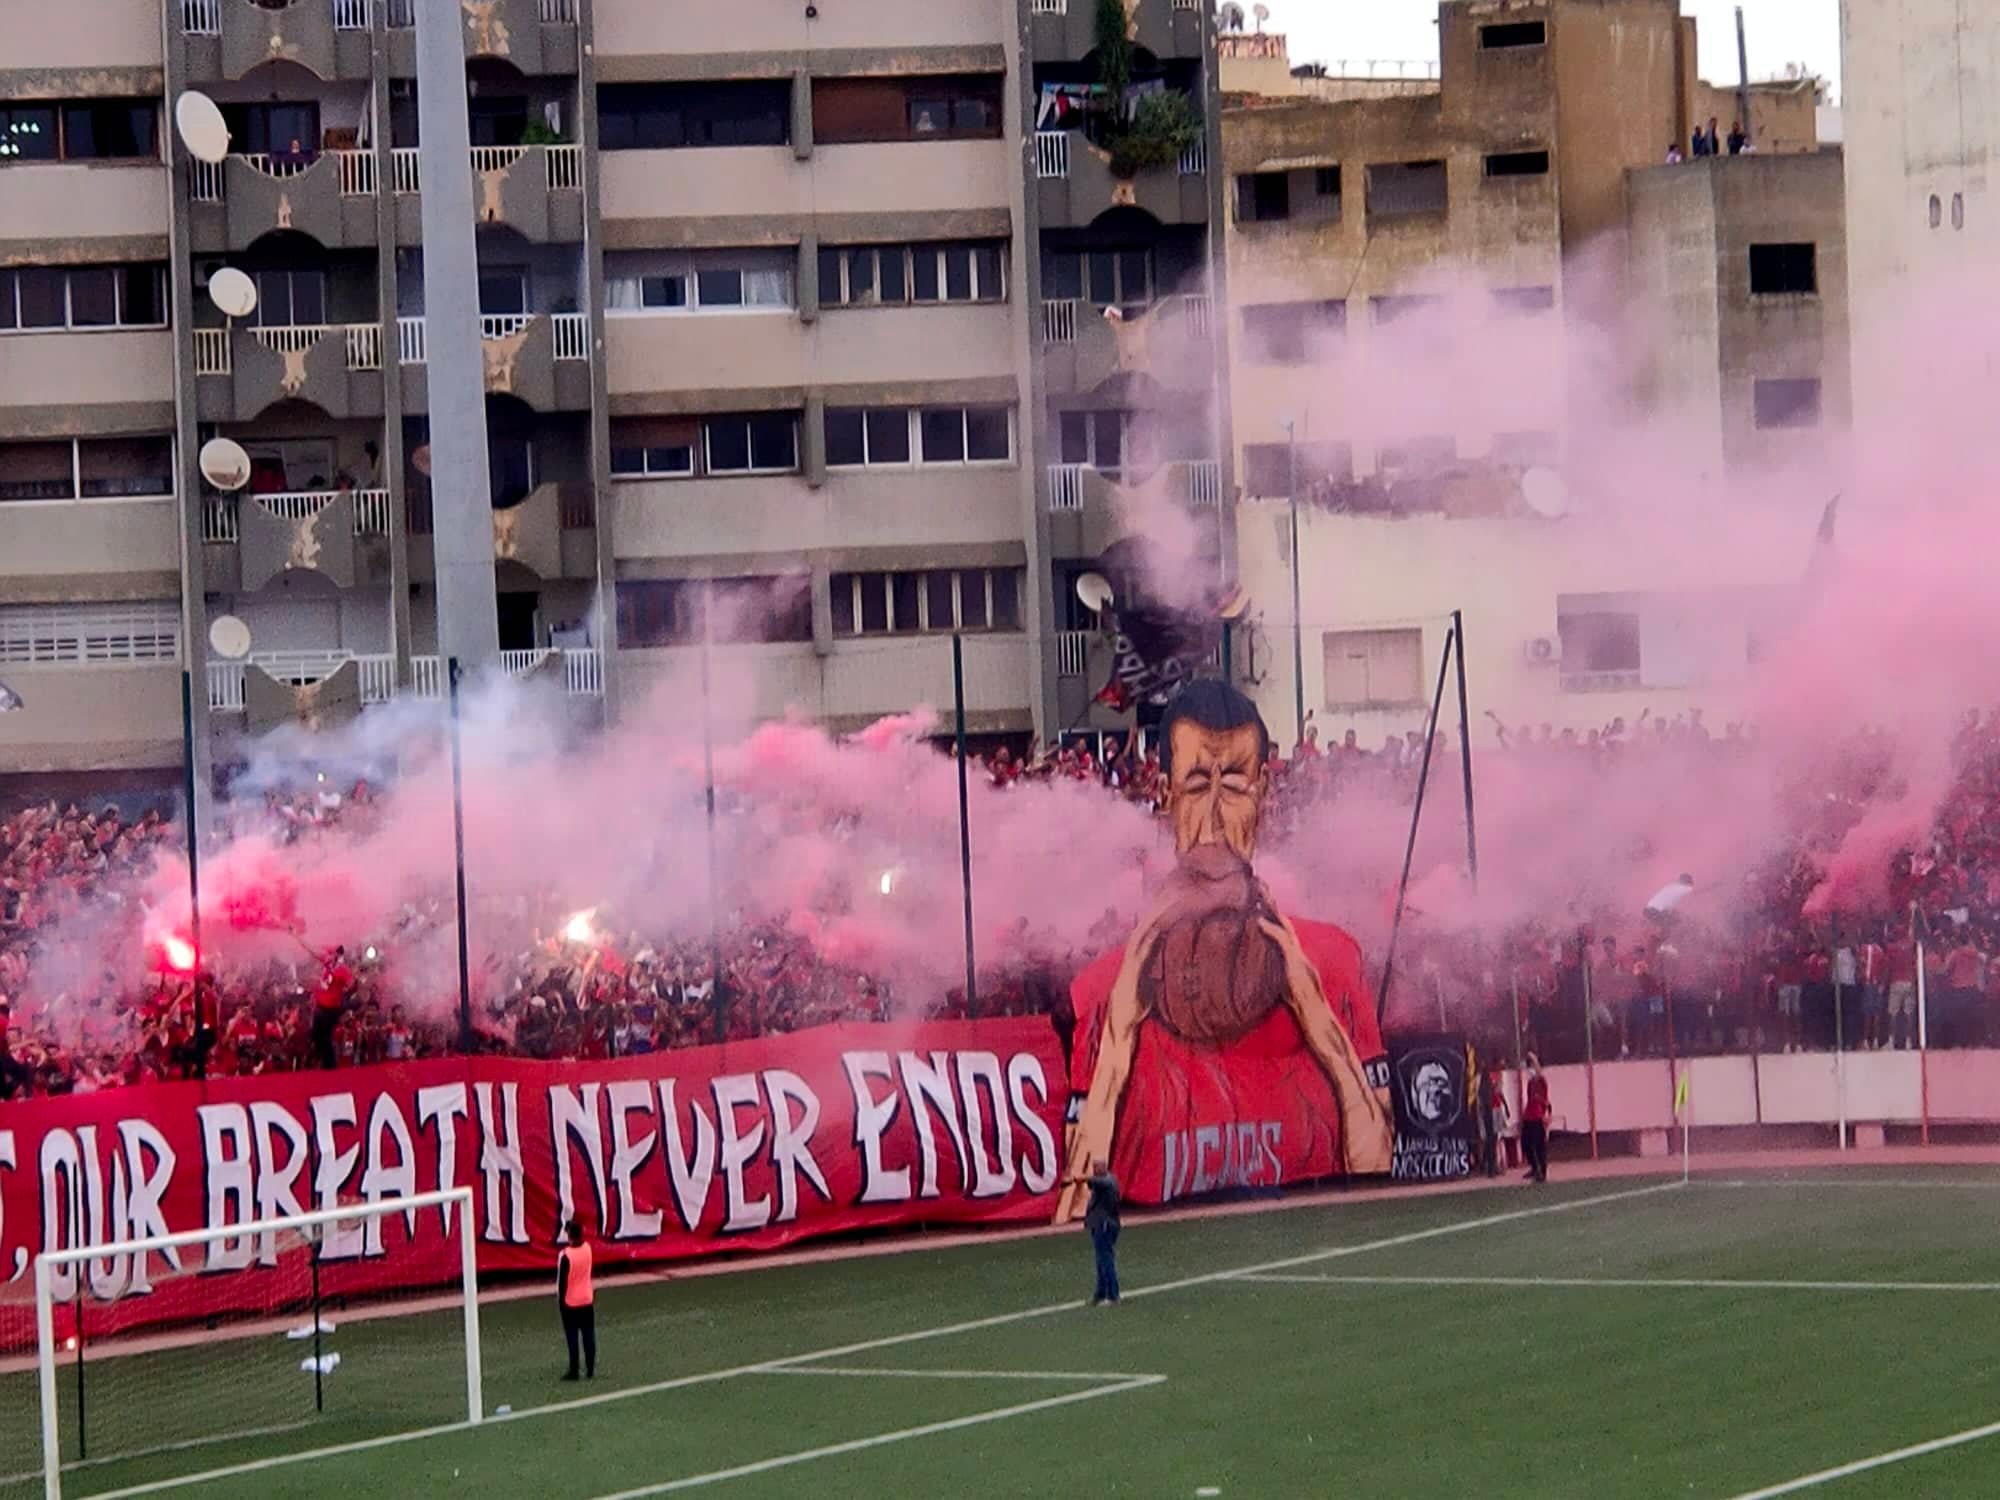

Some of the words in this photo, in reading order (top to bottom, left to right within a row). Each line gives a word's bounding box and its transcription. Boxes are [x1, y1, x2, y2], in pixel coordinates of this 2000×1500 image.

[40, 1118, 183, 1301] OUR
[197, 1081, 530, 1272] BREATH
[549, 1069, 832, 1243] NEVER
[842, 1050, 1058, 1203] ENDS
